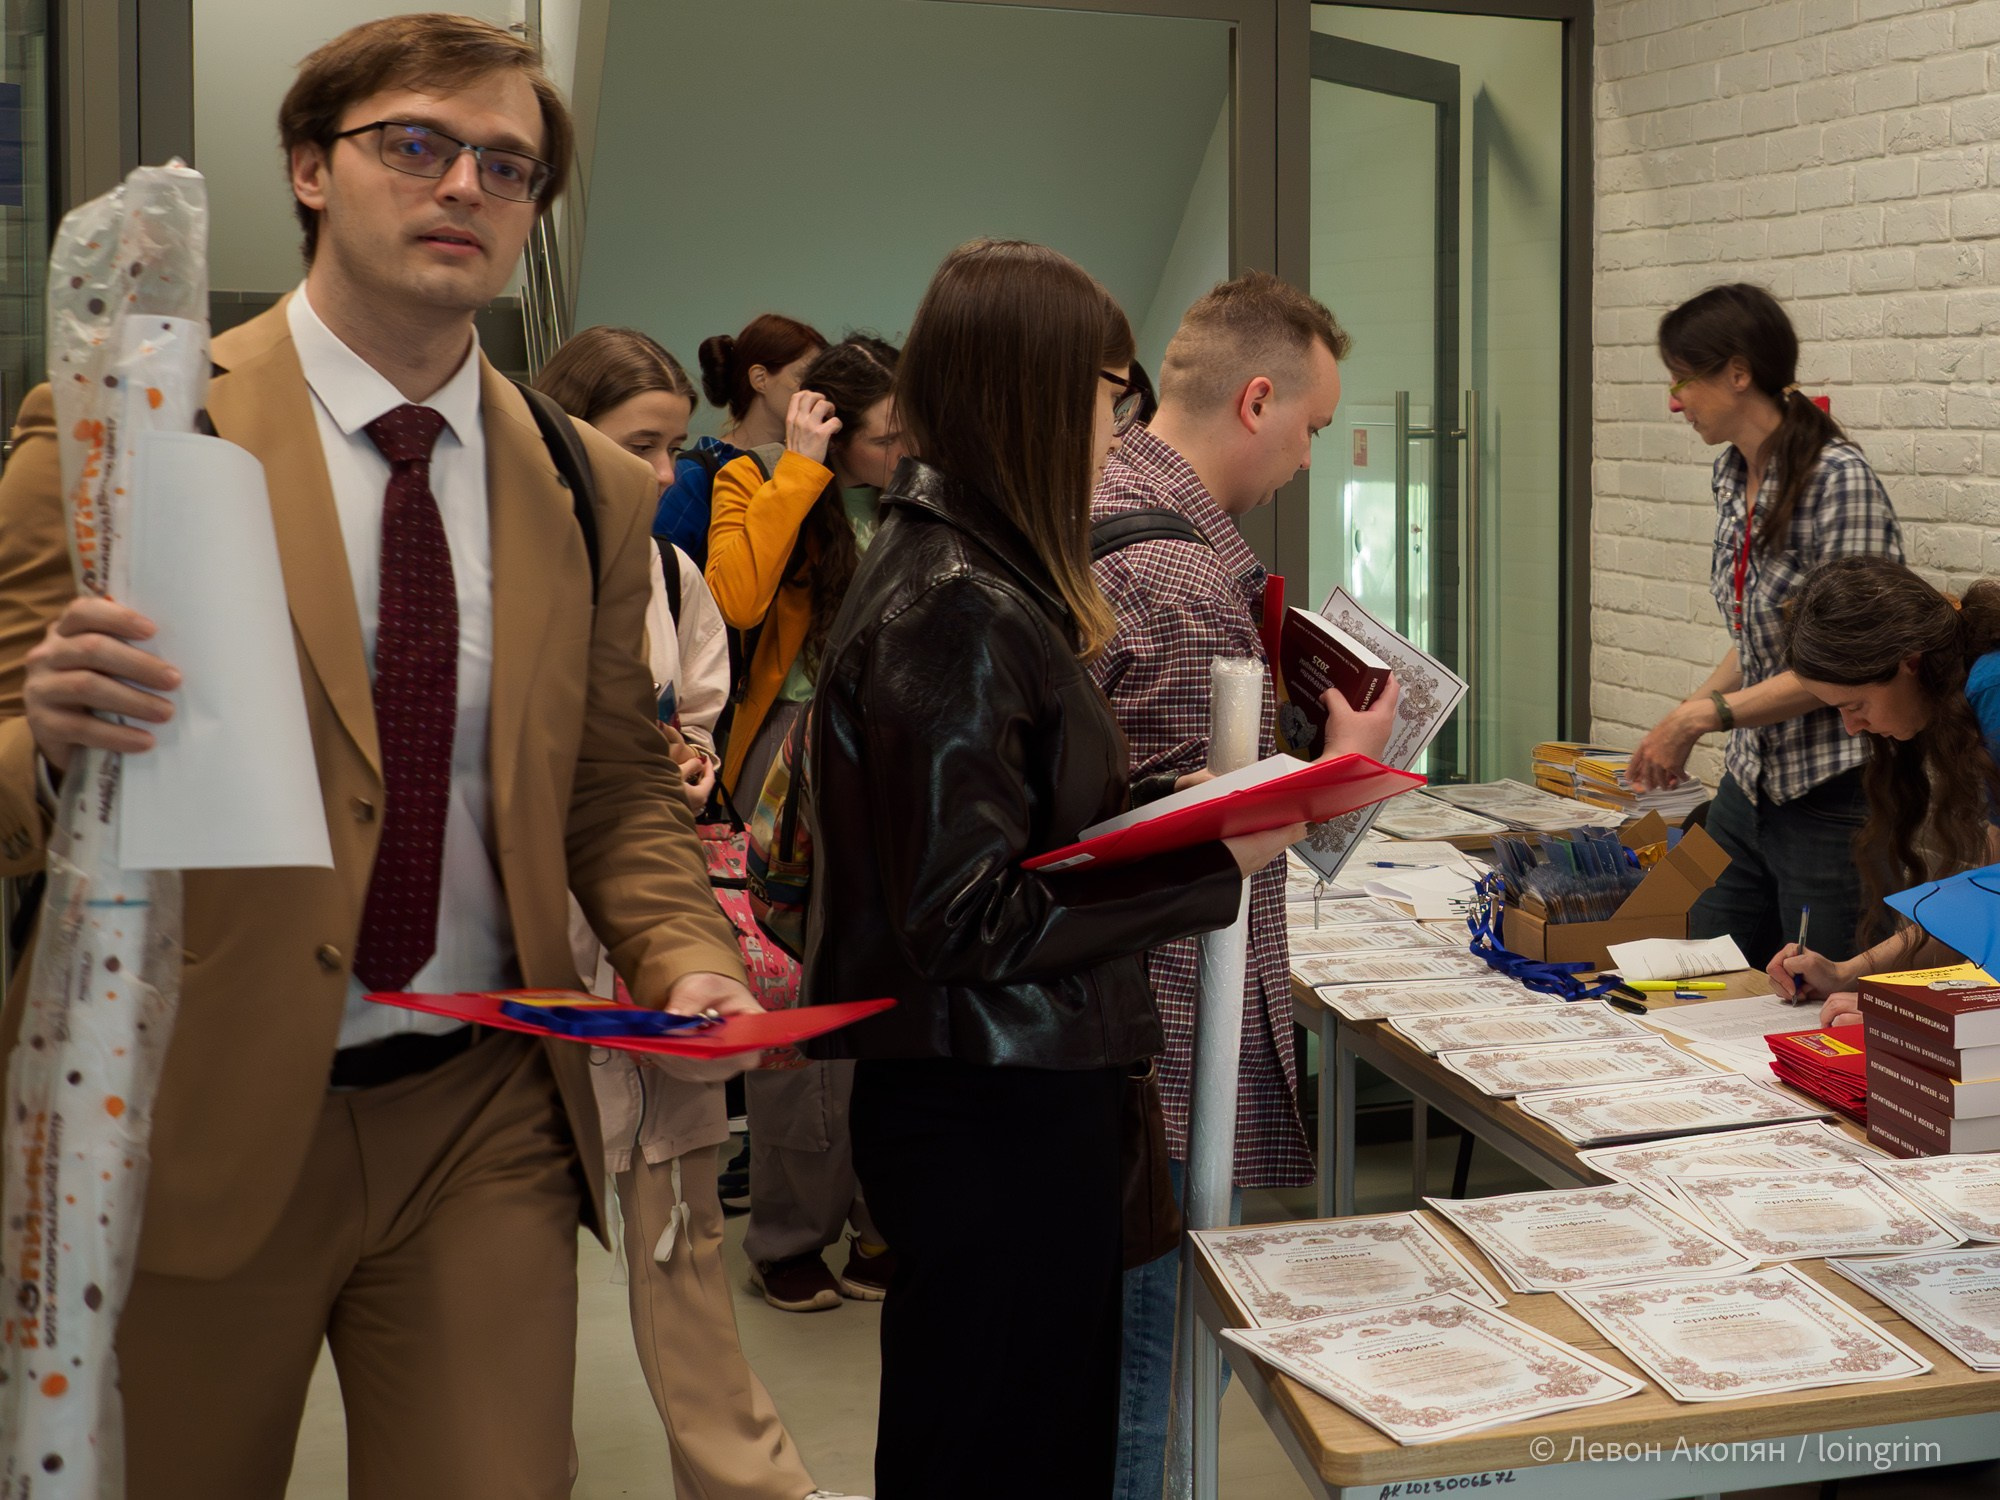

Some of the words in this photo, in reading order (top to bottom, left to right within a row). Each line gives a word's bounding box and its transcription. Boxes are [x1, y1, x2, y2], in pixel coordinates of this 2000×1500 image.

[1312, 655, 1330, 674] 2025
[1299, 667, 1327, 692] АТЕРИАЛЫ
[1360, 677, 1378, 712] КОГНИТИ
[1874, 997, 1893, 1010] МОСКВЕ
[1899, 1008, 1915, 1019] НАУКА
[1915, 1014, 1949, 1033] КОГНИТИВНАЯ
[1881, 1032, 1899, 1045] МОСКВЕ
[1904, 1041, 1920, 1053] НАУКА
[1921, 1048, 1955, 1067] КОГНИТИВНАЯ
[1870, 1060, 1899, 1080] КОГНИТИВНАЯ
[1900, 1075, 1914, 1086] НАУКА
[1920, 1084, 1938, 1098] МОСКВЕ
[1870, 1092, 1898, 1111] КОГНИТИВНАЯ
[1899, 1107, 1913, 1118] НАУКА
[1918, 1117, 1935, 1131] МОСКВЕ
[1900, 1141, 1915, 1152] НАУКА
[1285, 1251, 1373, 1265] Сертификат
[1672, 1310, 1762, 1325] Сертификат
[1356, 1340, 1446, 1361] Сертификат
